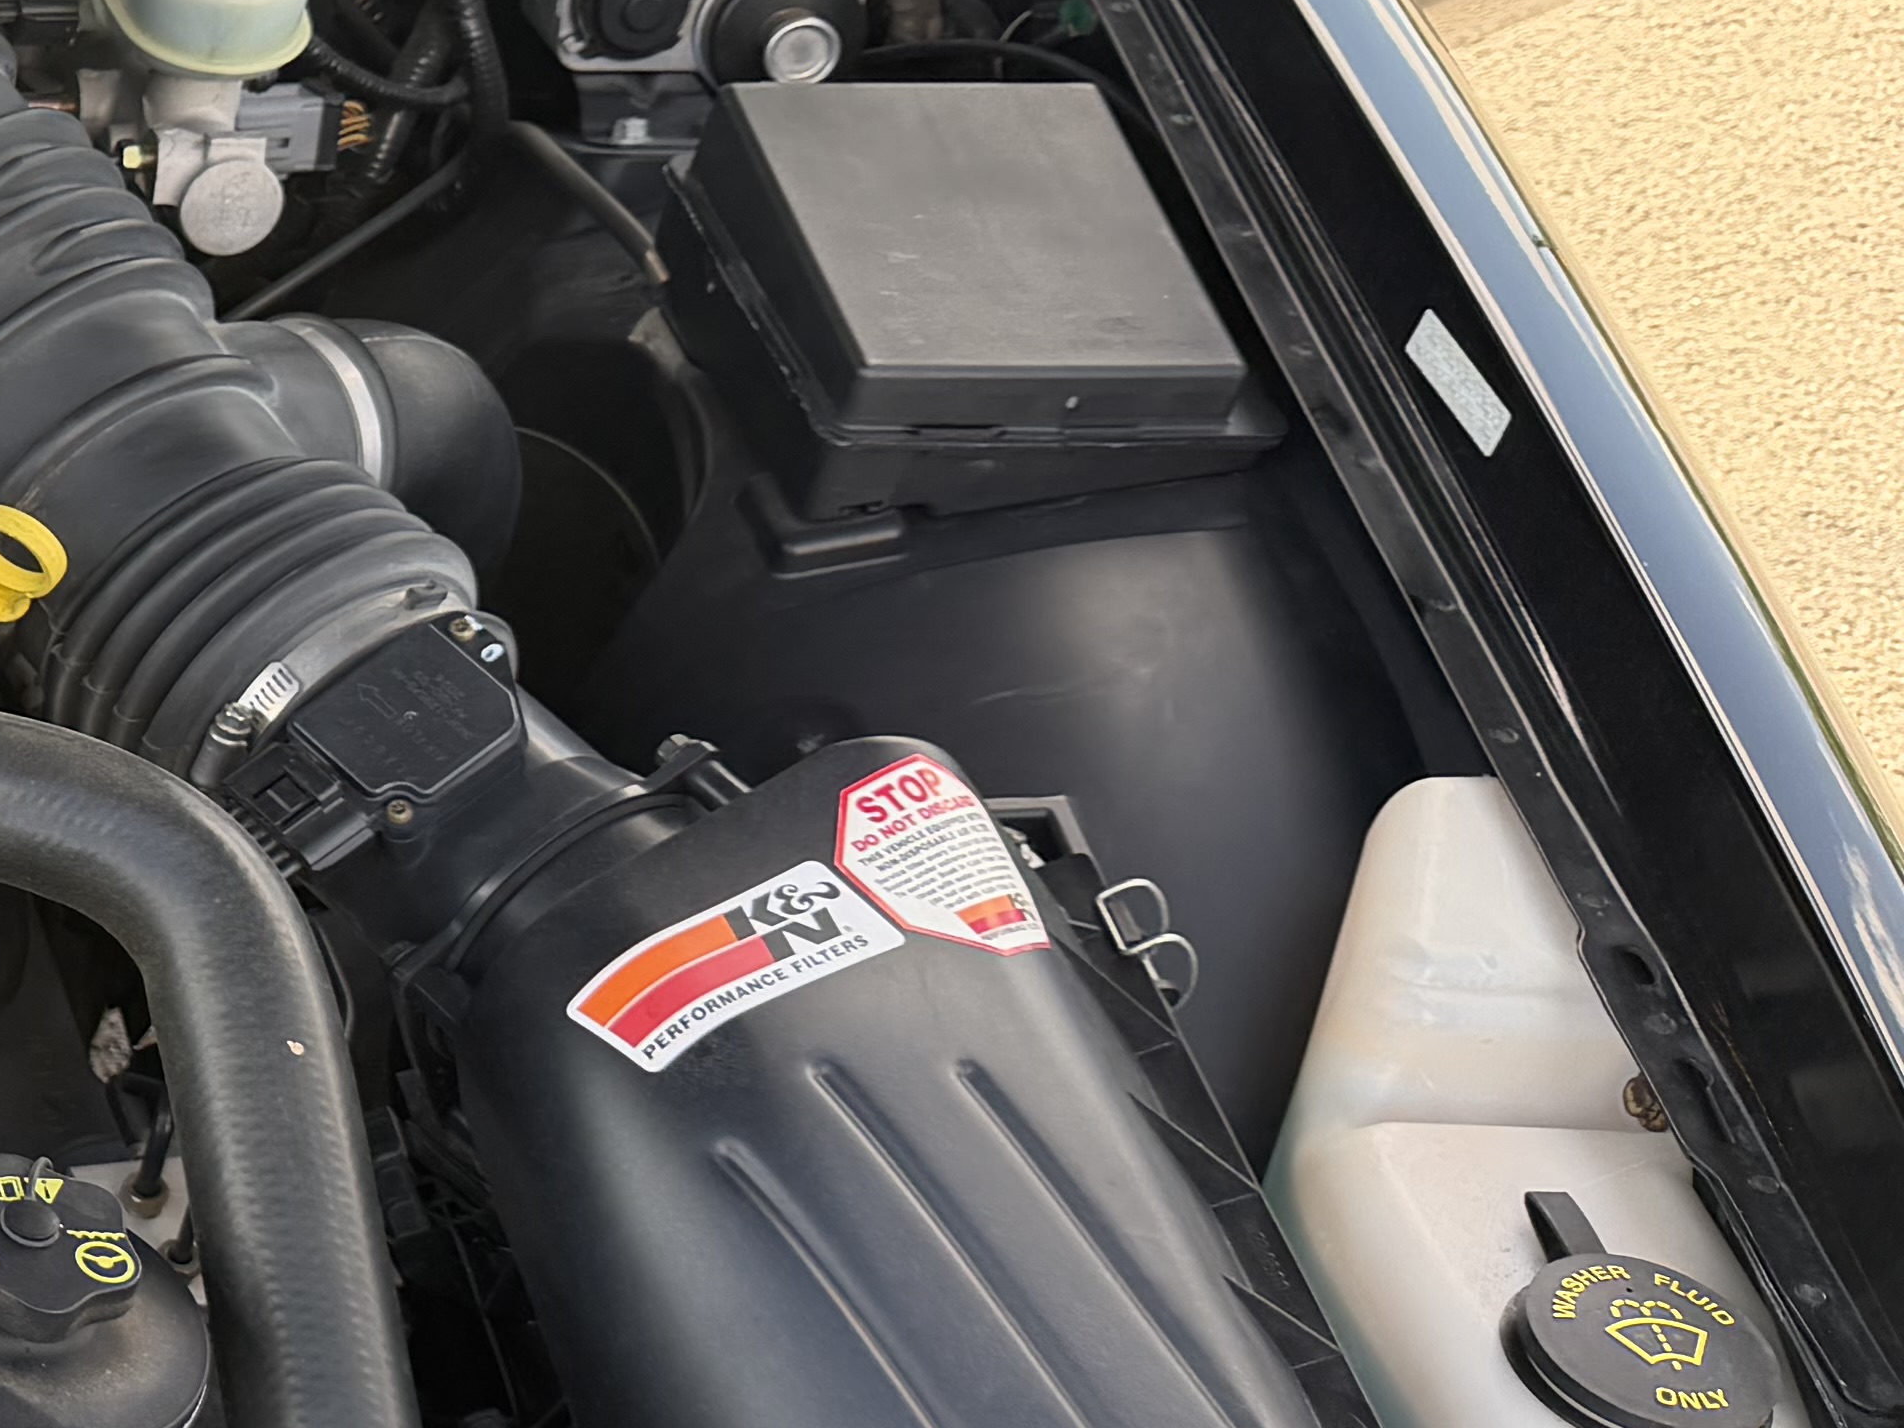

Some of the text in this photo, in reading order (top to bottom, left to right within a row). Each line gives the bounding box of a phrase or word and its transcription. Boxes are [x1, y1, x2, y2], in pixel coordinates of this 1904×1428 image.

[856, 768, 942, 822] STOP
[851, 813, 919, 852] DO NOT
[885, 830, 923, 855] VEHICLE
[642, 934, 869, 1060] PERFORMANCE FILTERS
[1552, 1265, 1735, 1325] WASHER FLUID
[1655, 1387, 1729, 1410] ONLY
